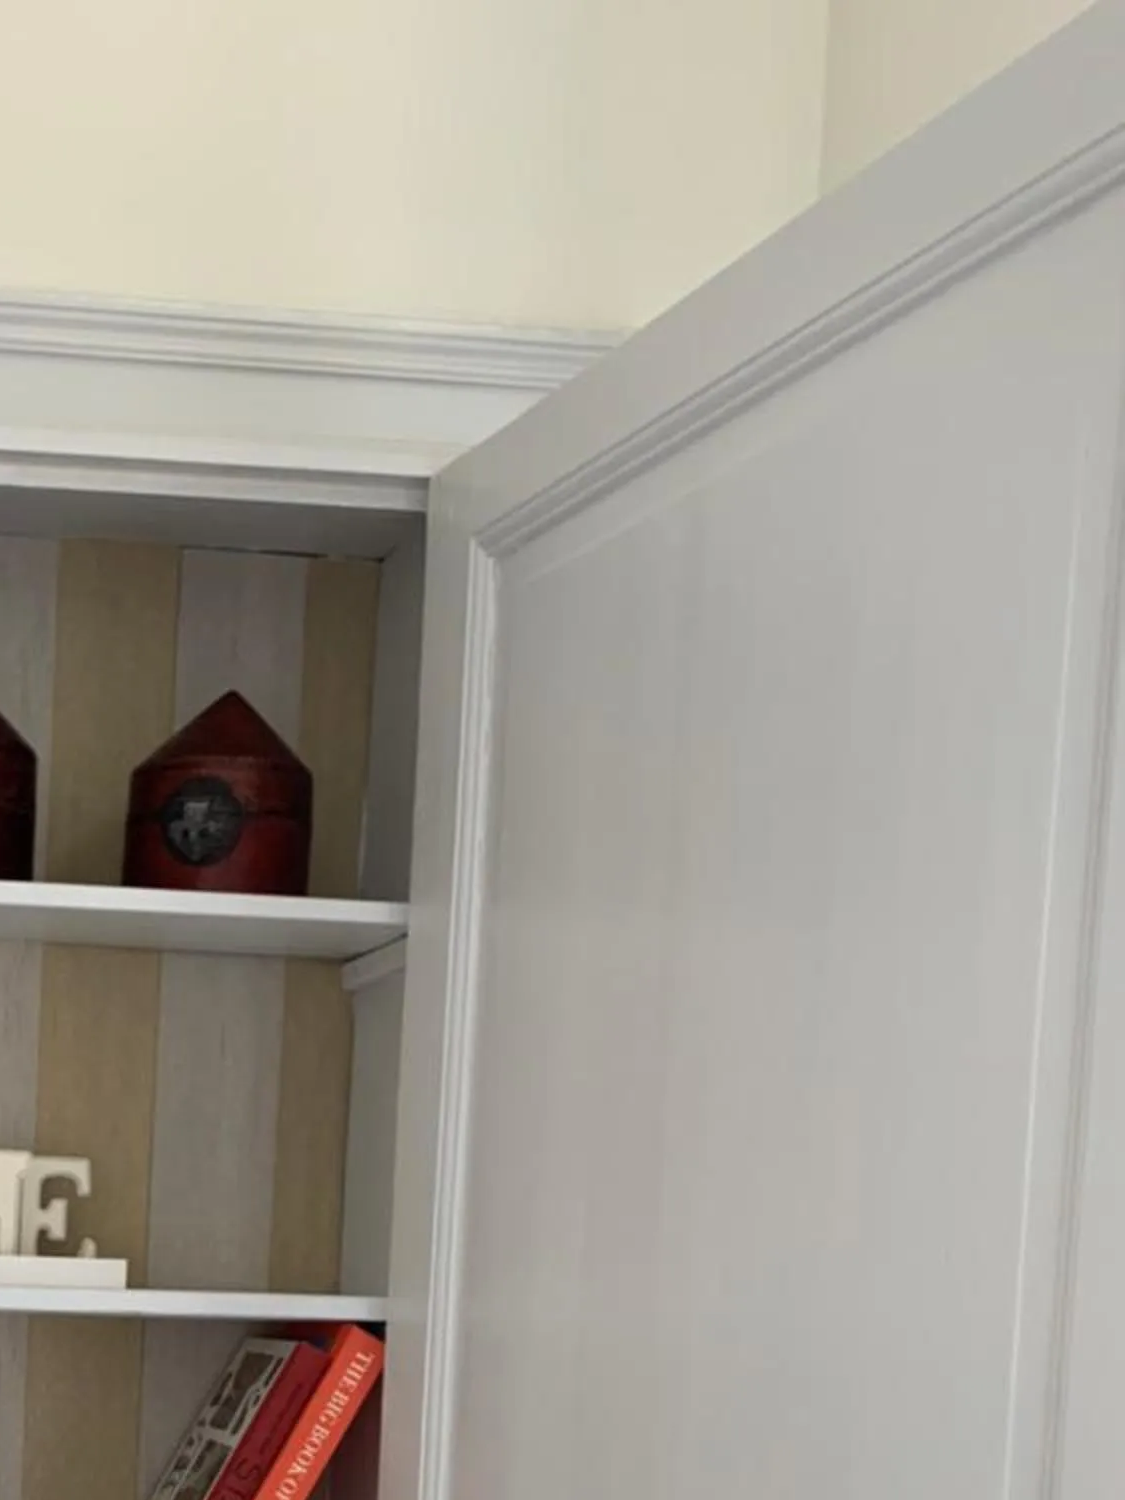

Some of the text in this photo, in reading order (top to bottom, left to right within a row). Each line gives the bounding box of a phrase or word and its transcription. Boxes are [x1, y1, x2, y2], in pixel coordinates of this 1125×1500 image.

[339, 1350, 376, 1393] THE
[319, 1389, 351, 1426] BIG
[286, 1423, 332, 1476] BOOK
